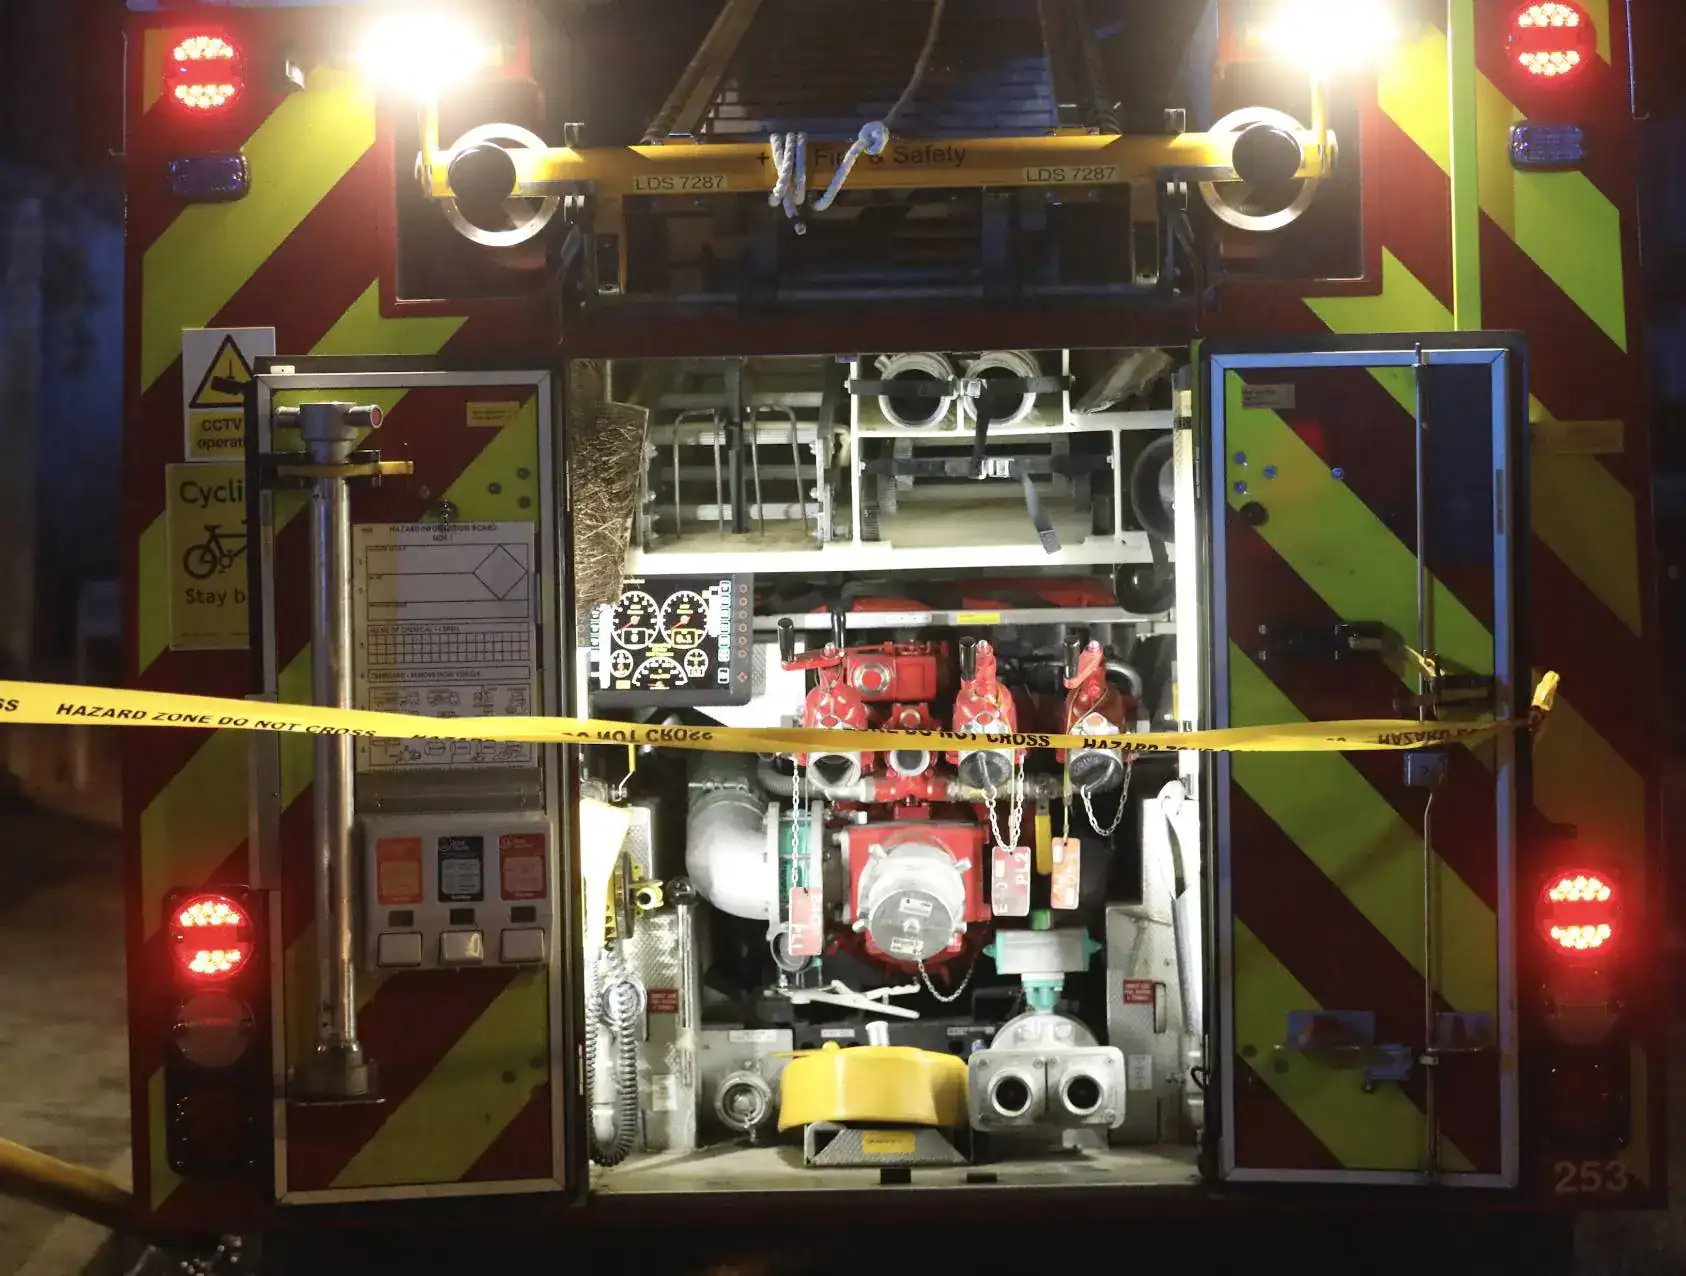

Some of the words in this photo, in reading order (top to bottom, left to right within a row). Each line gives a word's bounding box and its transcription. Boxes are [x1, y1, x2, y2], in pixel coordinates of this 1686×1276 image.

[814, 147, 843, 168] Fir
[893, 144, 967, 168] Safety
[635, 175, 676, 191] LDS
[679, 174, 725, 190] 7287
[1025, 168, 1066, 182] LDS
[1071, 166, 1117, 182] 7287
[201, 418, 243, 432] CCTV
[196, 438, 245, 452] operat
[179, 478, 244, 509] Cycli
[185, 588, 227, 608] Stay
[56, 703, 148, 720] HAZARD
[151, 711, 215, 724] ZONE
[217, 716, 249, 726] DO
[254, 719, 301, 732] NOT
[304, 724, 378, 737] CROSS
[986, 732, 1051, 748] CROSS
[1553, 1159, 1629, 1194] 253
